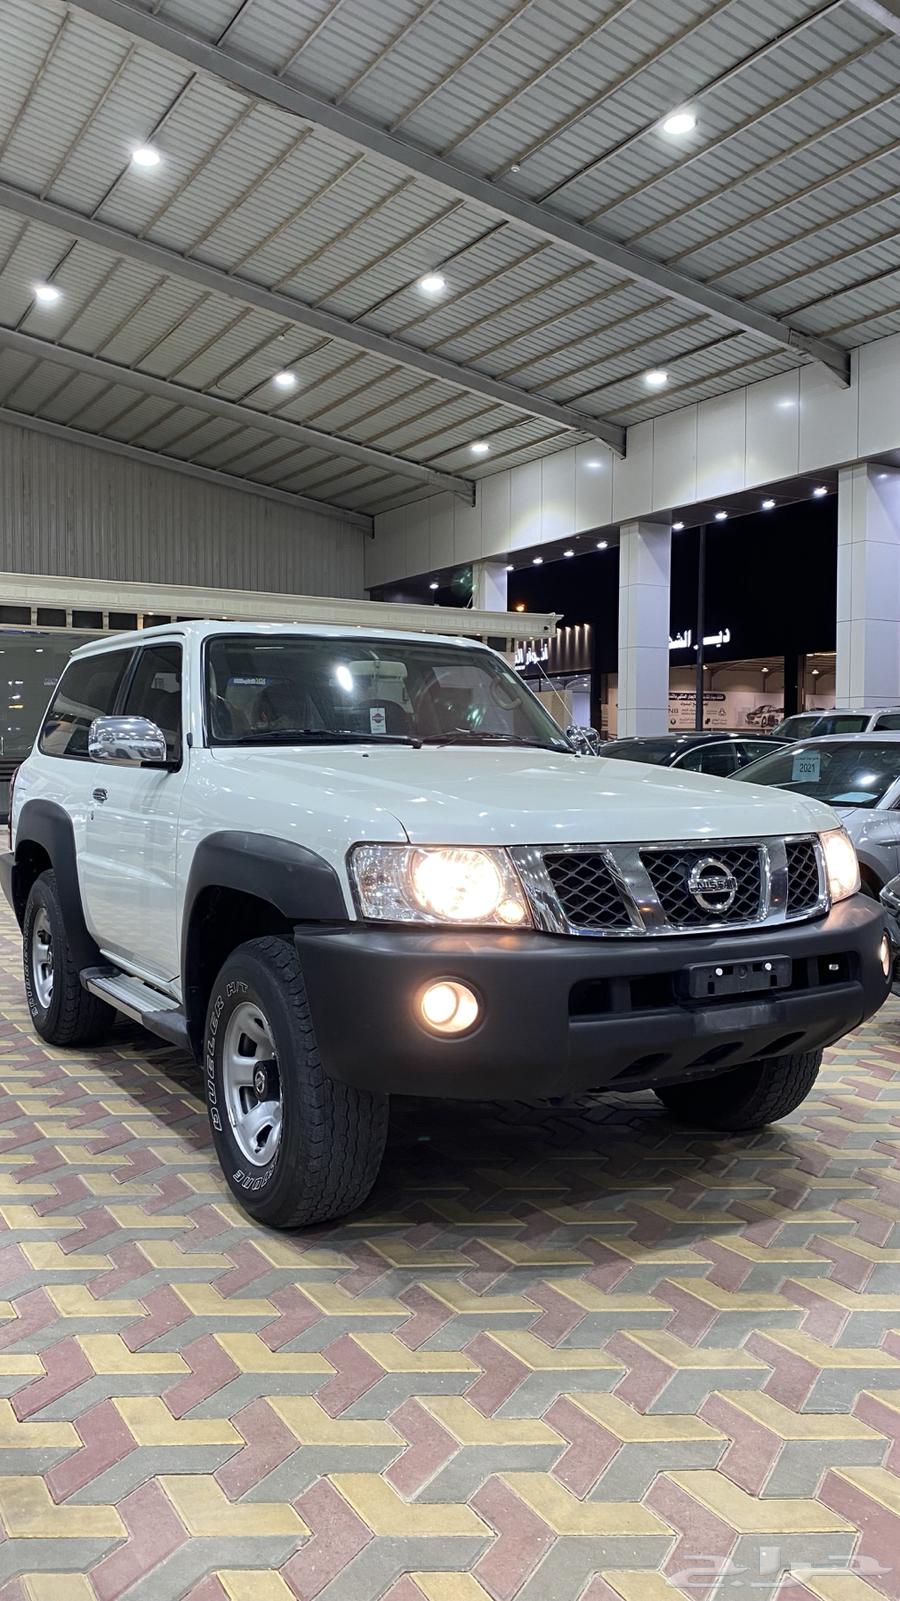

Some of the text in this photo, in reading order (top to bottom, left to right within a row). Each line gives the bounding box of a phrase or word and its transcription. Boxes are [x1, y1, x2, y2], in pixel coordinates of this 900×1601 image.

[799, 763, 816, 773] 2021
[697, 878, 737, 892] NISSAN
[206, 981, 249, 1132] DUELER H/T
